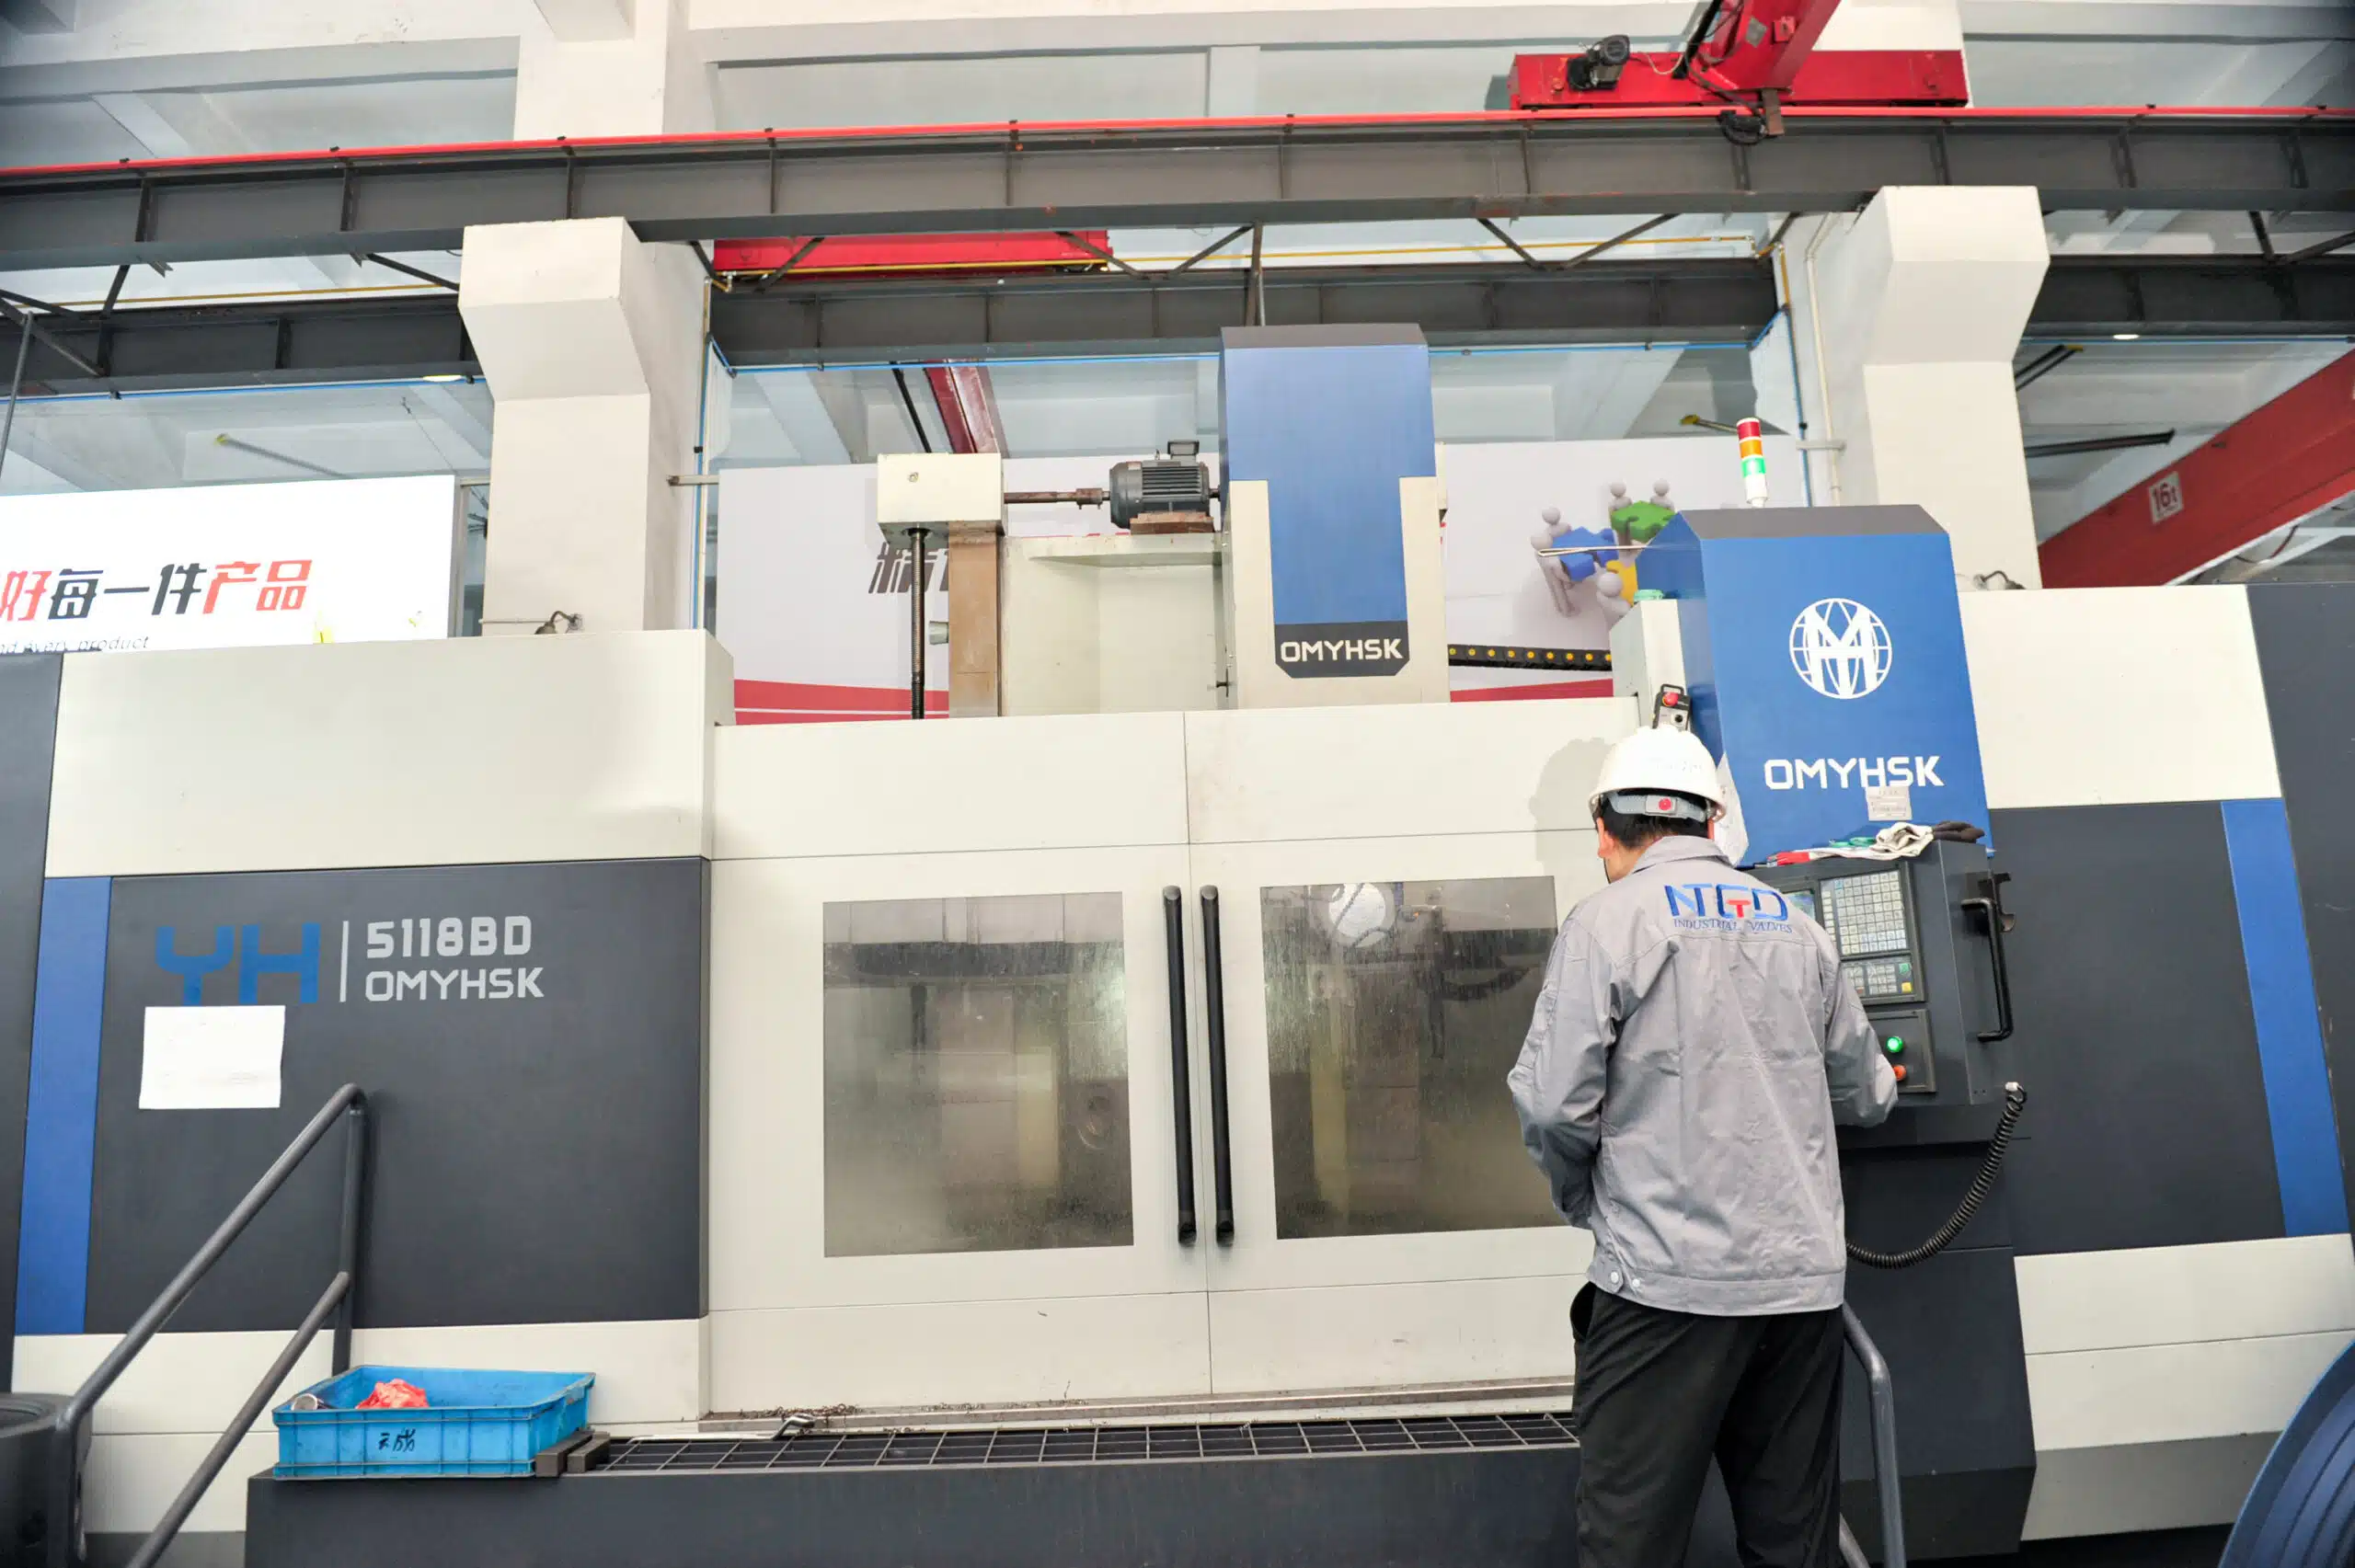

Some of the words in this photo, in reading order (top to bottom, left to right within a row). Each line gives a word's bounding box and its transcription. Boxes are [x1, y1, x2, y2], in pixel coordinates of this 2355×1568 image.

[0, 559, 312, 622] 好每一件产品
[77, 636, 149, 651] product
[1280, 638, 1404, 662] OMYHSK
[1763, 755, 1945, 790] OMYHSK
[367, 916, 533, 958] 5118BD
[1674, 918, 1741, 933] INDUSTRIAL
[1748, 921, 1793, 934] VALVES
[155, 922, 321, 1005] YH
[365, 967, 544, 1001] OMYHSK
